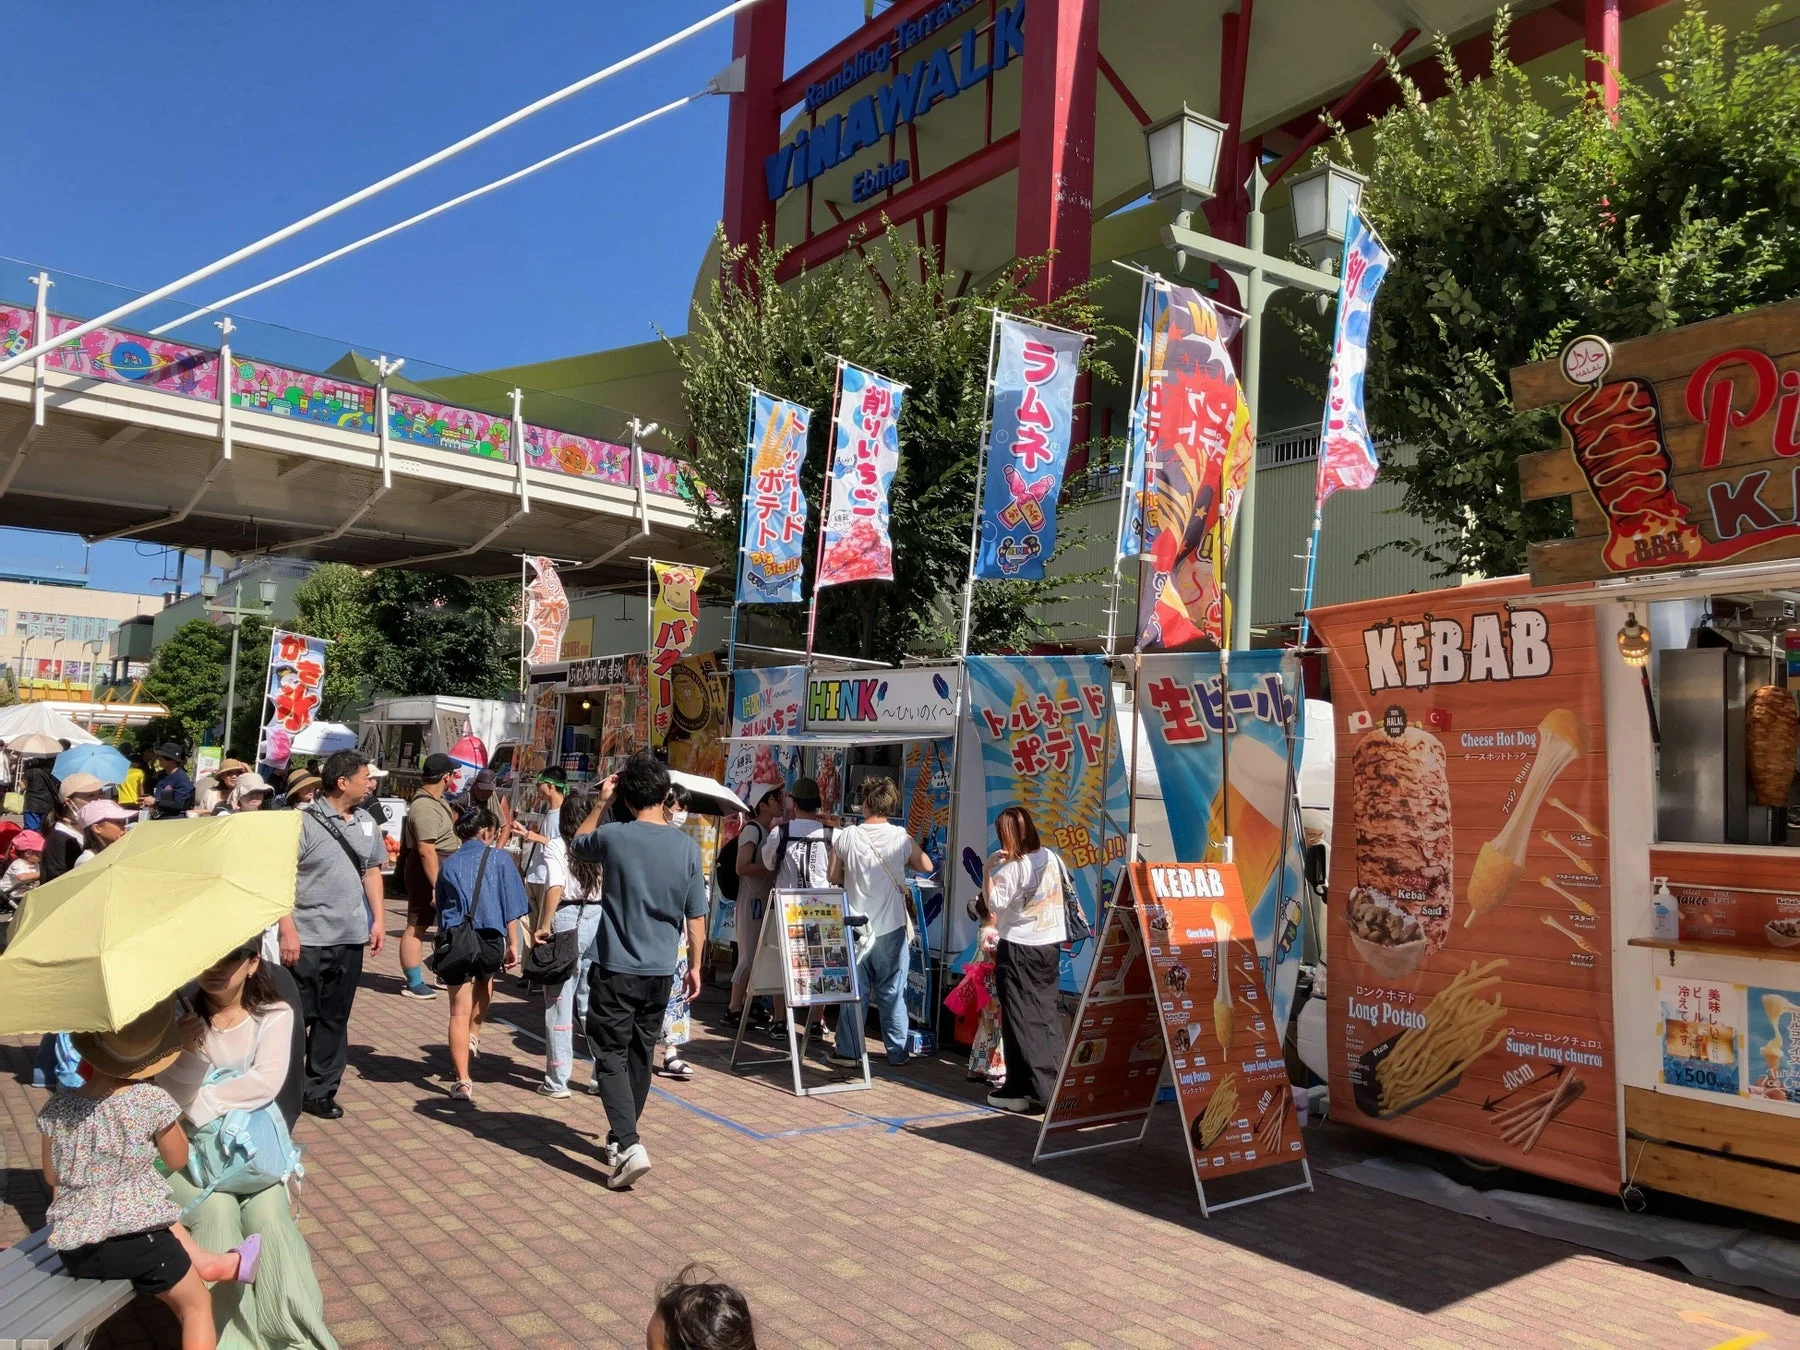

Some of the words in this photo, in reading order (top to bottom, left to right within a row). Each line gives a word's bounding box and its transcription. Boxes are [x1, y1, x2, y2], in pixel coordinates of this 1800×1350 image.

[805, 42, 892, 113] Rambling
[851, 158, 910, 203] Ebina
[1568, 348, 1604, 371] حلال
[1576, 363, 1602, 378] HALAL
[1011, 341, 1058, 471] ラムネ
[857, 386, 890, 517] 削りいちごー
[755, 470, 784, 546] ポテト
[751, 552, 774, 566] Big
[1363, 609, 1553, 690] KEBAB
[279, 634, 323, 733] かき氷
[808, 679, 878, 721] HINK
[983, 684, 1105, 739] トルネード
[1148, 674, 1294, 743] 生ビール
[1386, 717, 1404, 727] HALAL
[1011, 724, 1104, 775] ポテト
[1461, 733, 1494, 747] Cheese
[1496, 731, 1514, 746] Hot
[1517, 731, 1536, 748] Dog
[1053, 824, 1090, 848] Big
[1150, 866, 1226, 898] KEBAB
[1348, 996, 1379, 1027] Long
[1382, 1001, 1427, 1030] Potato
[1678, 985, 1690, 1046] 冷えてます
[1693, 987, 1704, 1023] ビール
[1256, 1060, 1268, 1071] Long
[1506, 1037, 1536, 1057] Super
[1537, 1042, 1563, 1063] Long
[1180, 1073, 1194, 1085] Long
[1502, 1063, 1535, 1091] 40cm
